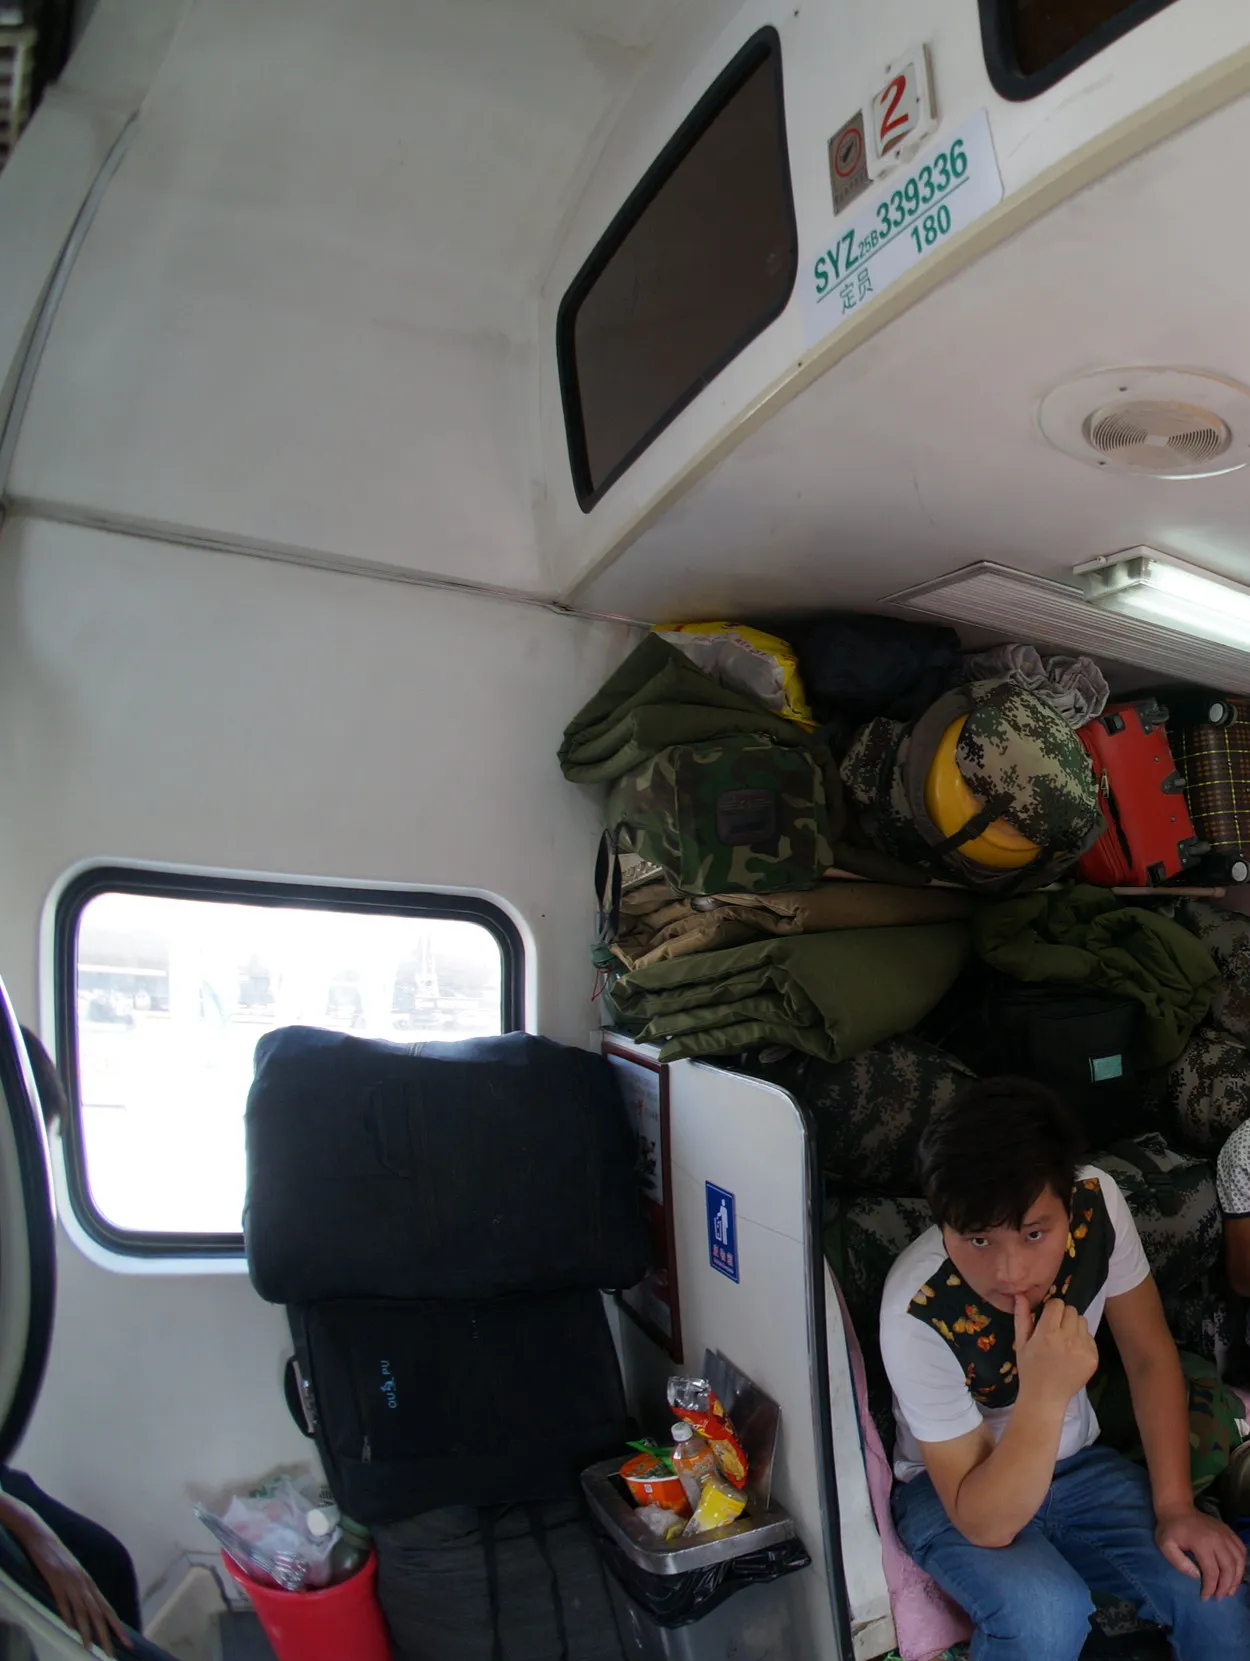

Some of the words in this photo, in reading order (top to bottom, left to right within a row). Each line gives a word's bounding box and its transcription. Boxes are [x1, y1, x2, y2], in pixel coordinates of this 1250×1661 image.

[879, 74, 909, 141] 2
[910, 205, 952, 254] 180
[839, 267, 874, 315] 定员
